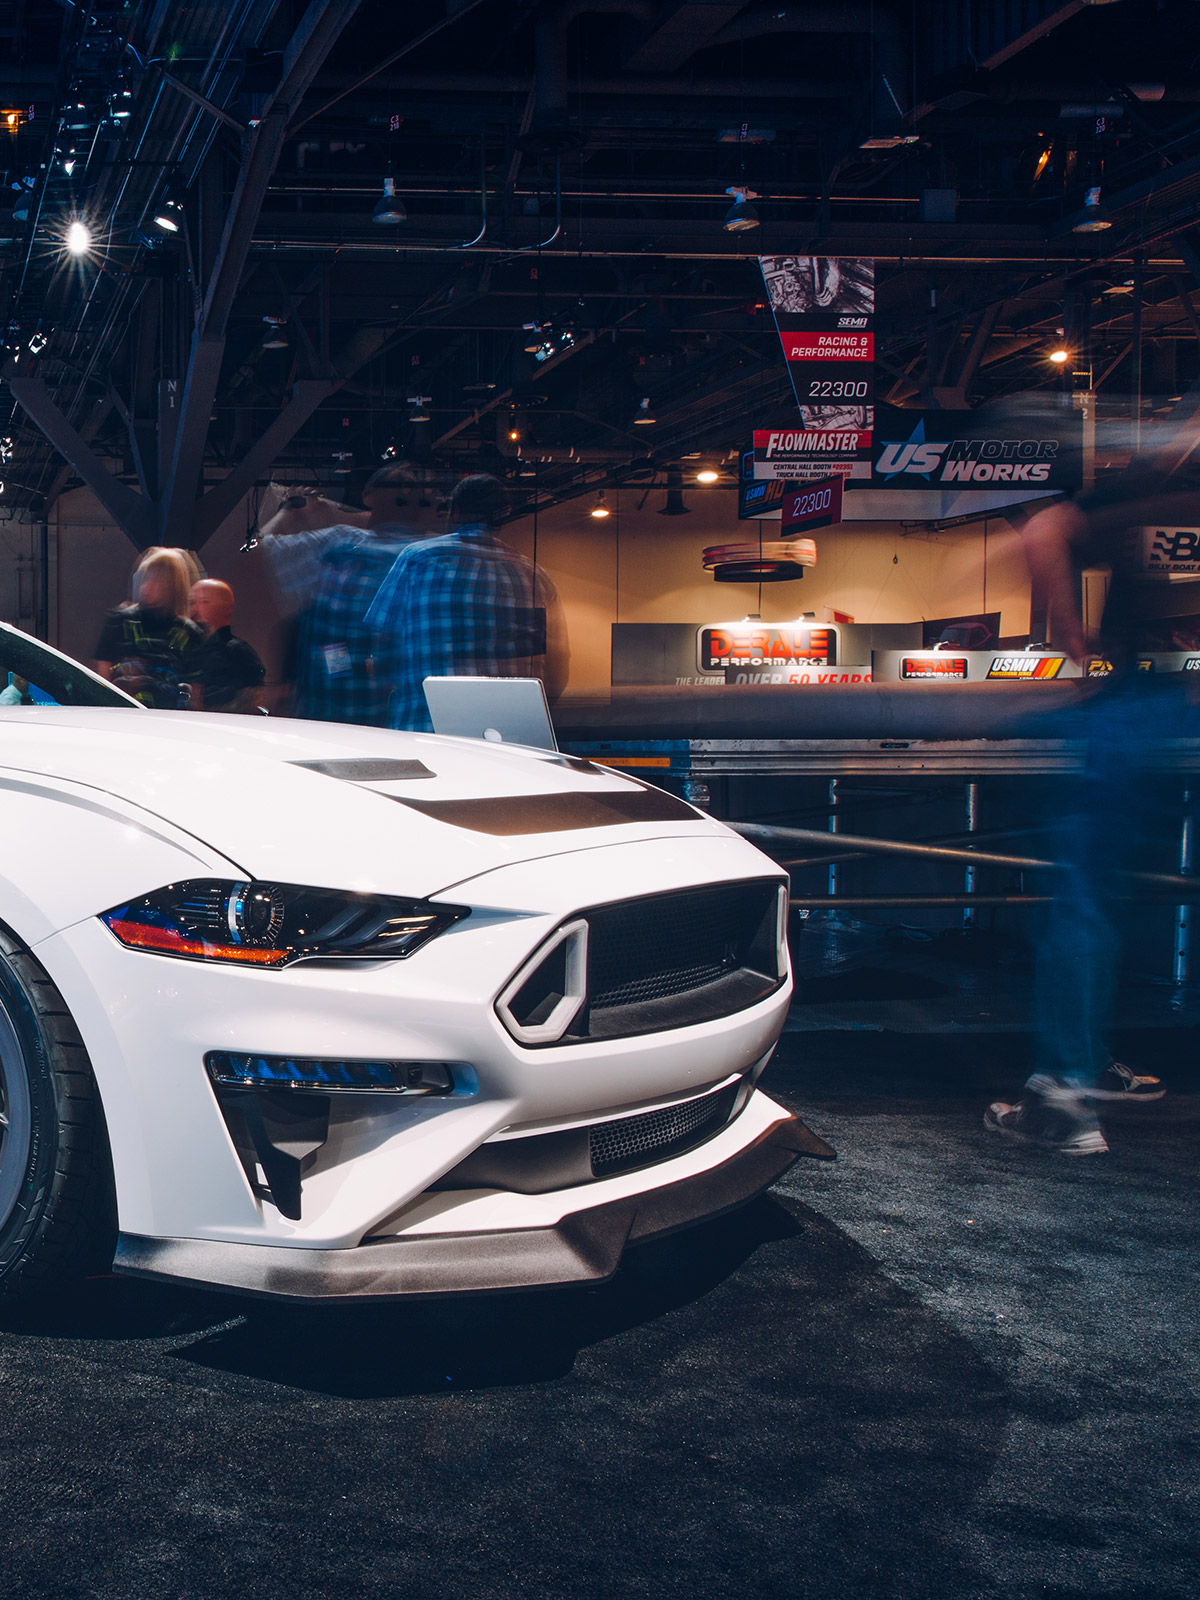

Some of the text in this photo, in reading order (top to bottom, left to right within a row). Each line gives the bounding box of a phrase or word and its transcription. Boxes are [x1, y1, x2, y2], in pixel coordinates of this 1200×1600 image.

[818, 336, 868, 346] RACING &
[791, 347, 868, 357] PERFORMANCE
[168, 379, 177, 392] N
[809, 381, 868, 397] 22300
[765, 433, 859, 458] FLOWMASTER
[875, 439, 1059, 474] US MOTOR
[939, 460, 1051, 482] WORKS
[792, 488, 832, 517] 22300
[992, 658, 1040, 672] USMW
[675, 677, 692, 686] THE
